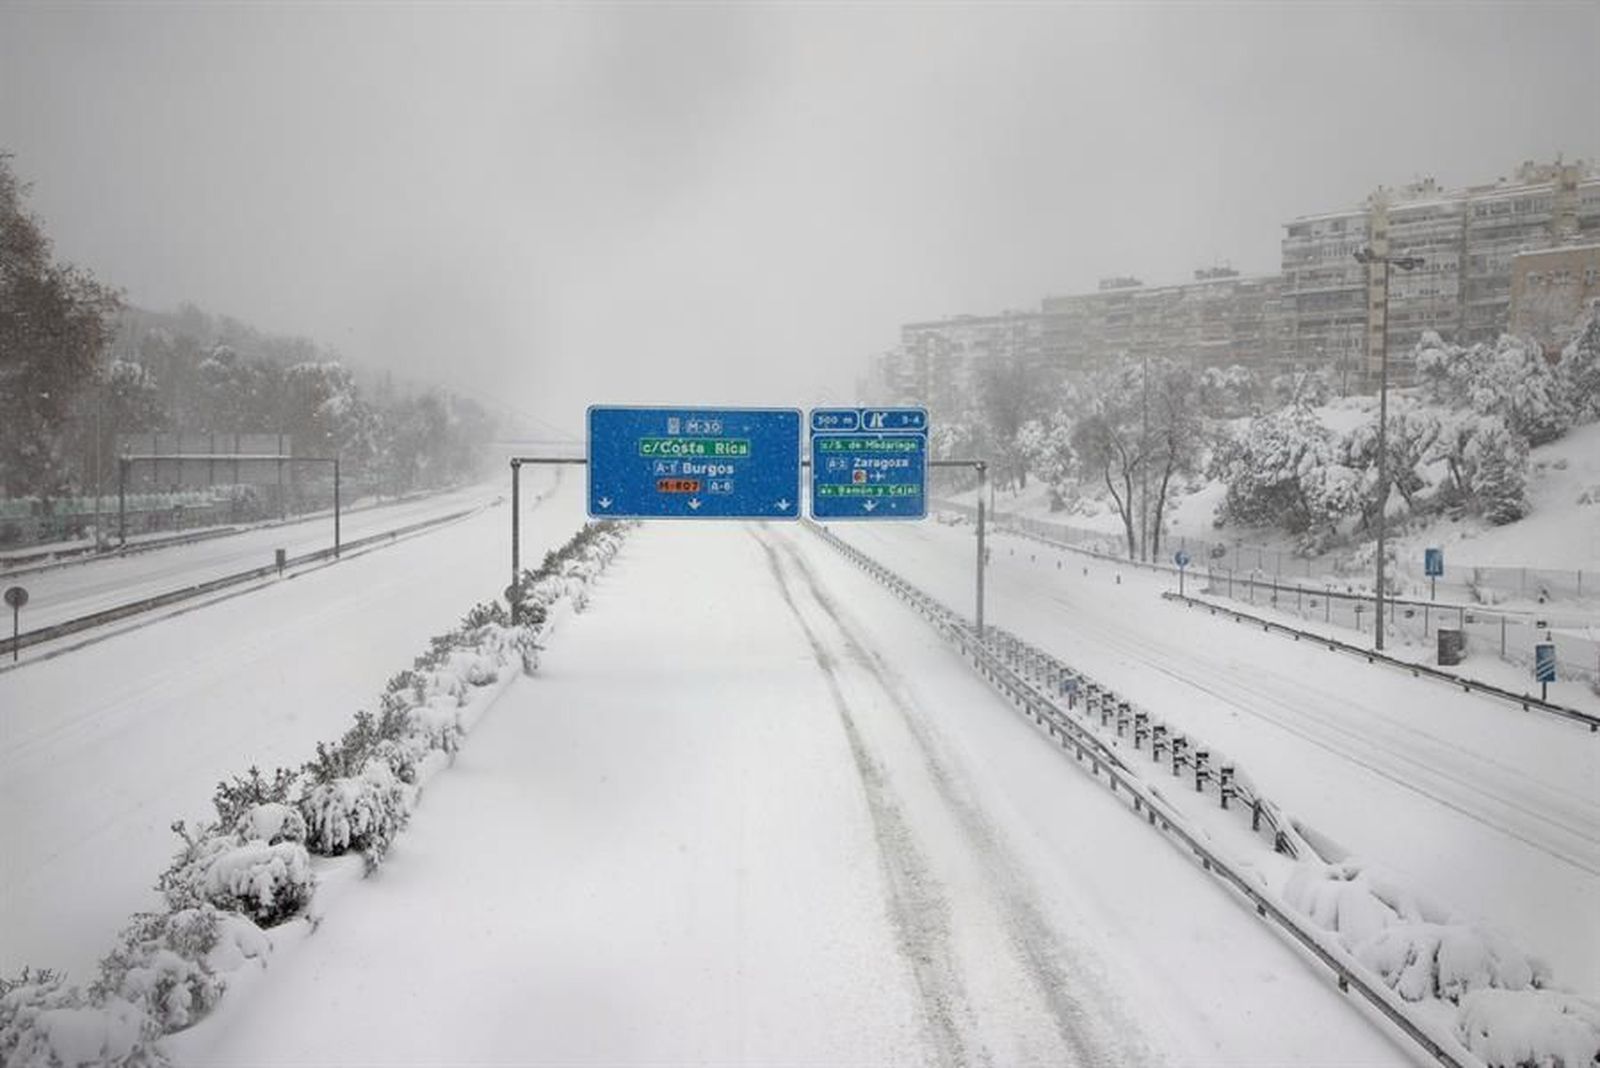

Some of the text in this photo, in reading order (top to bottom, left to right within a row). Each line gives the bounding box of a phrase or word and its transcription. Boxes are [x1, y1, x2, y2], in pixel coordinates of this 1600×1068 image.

[818, 416, 853, 425] 500 m
[686, 422, 720, 434] M-30
[642, 441, 747, 454] c/Costa Rica
[848, 441, 861, 450] de
[655, 462, 735, 477] A-1 Burgos
[854, 458, 909, 471] Zaragoza
[877, 487, 884, 496] y
[889, 485, 917, 496] Cajal
